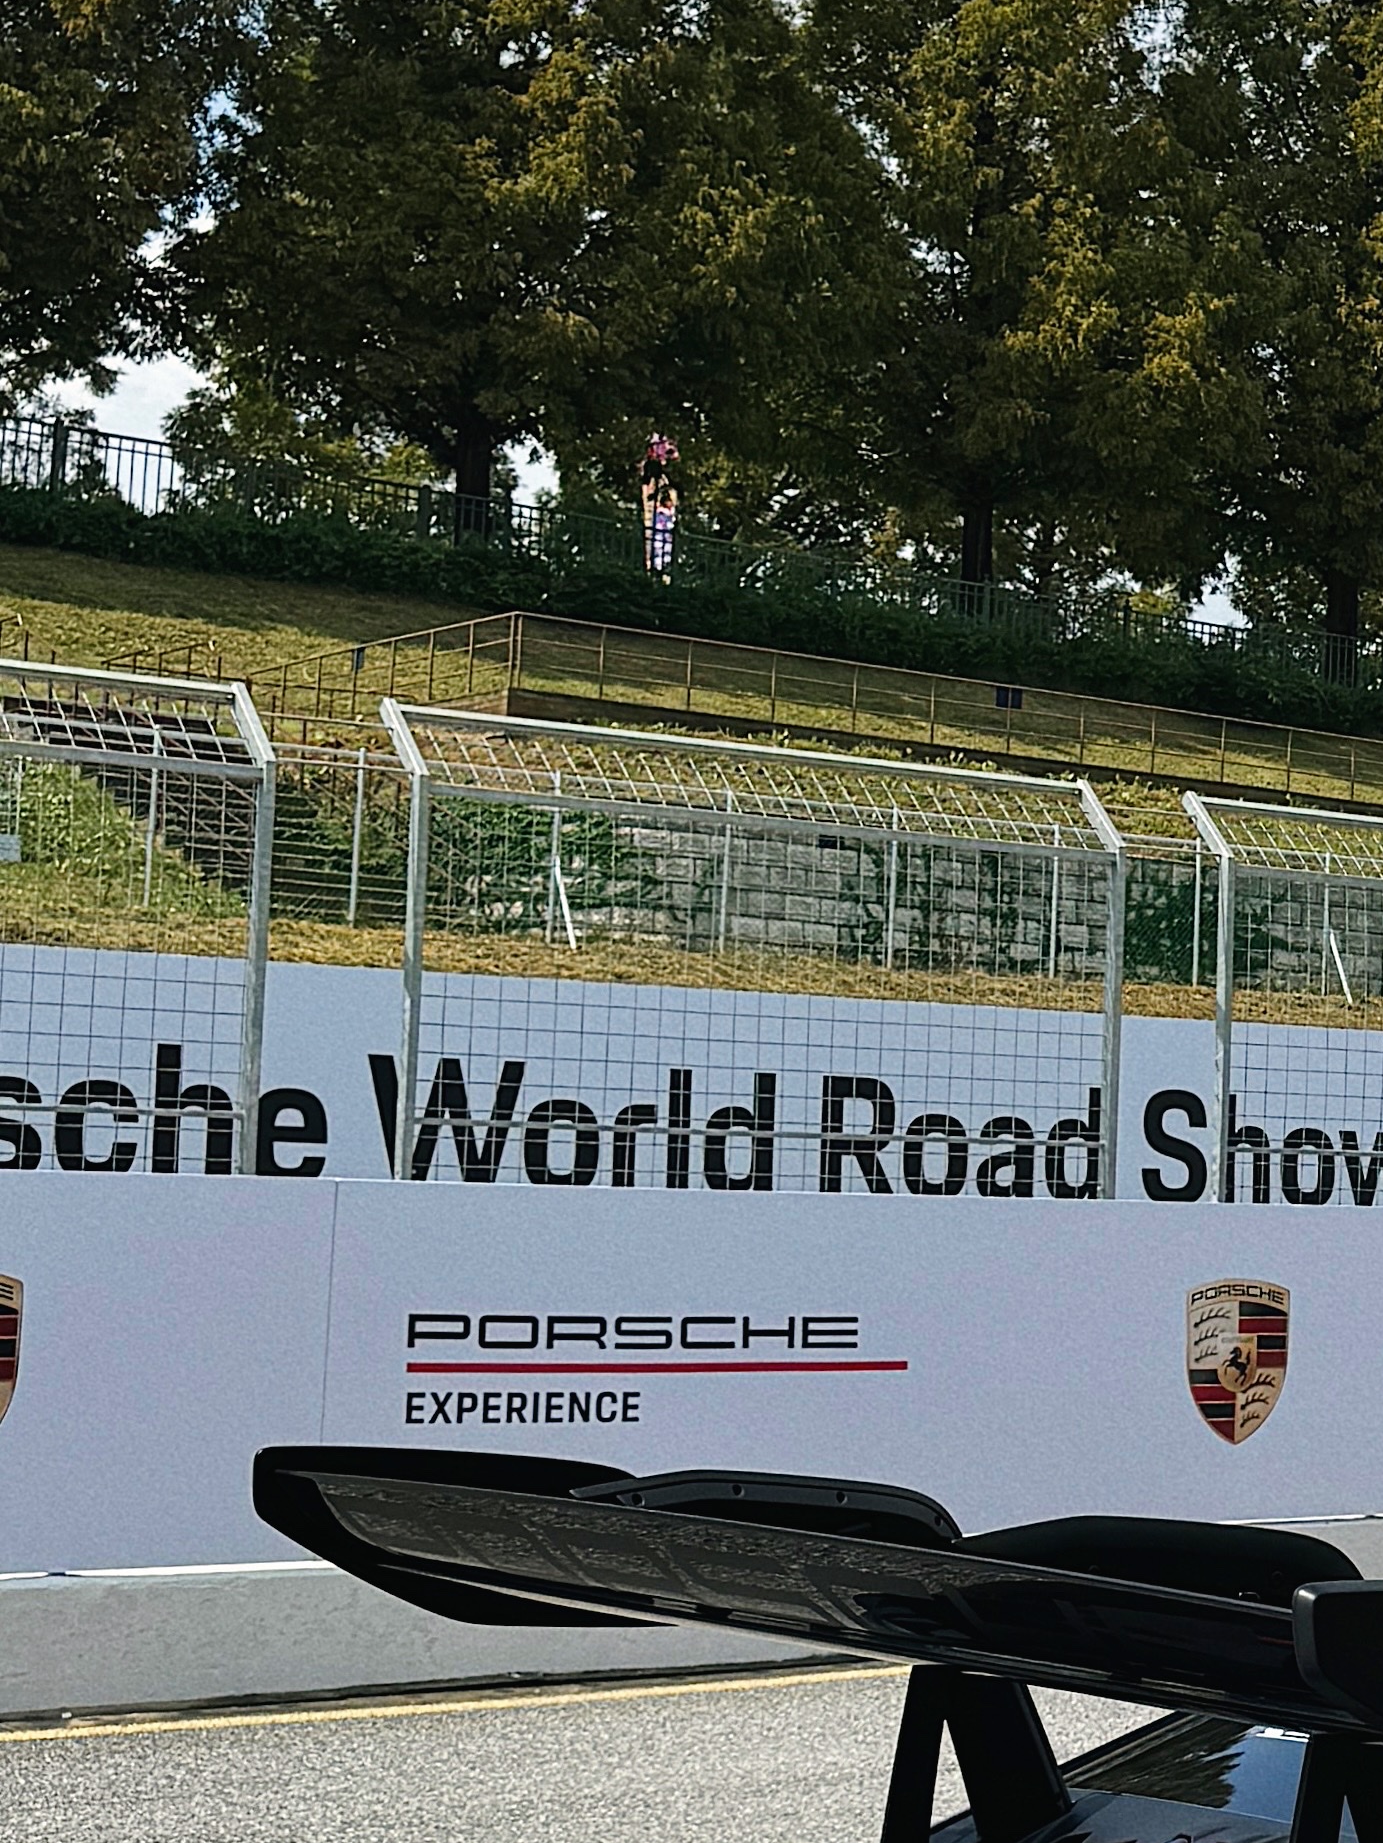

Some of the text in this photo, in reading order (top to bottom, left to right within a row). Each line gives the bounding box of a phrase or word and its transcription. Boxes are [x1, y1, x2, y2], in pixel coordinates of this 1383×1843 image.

[368, 1053, 776, 1192] World
[819, 1074, 1102, 1199] Road
[1190, 1284, 1285, 1306] PORSCHE
[407, 1313, 859, 1350] PORSCHE
[405, 1391, 641, 1425] EXPERIENCE
